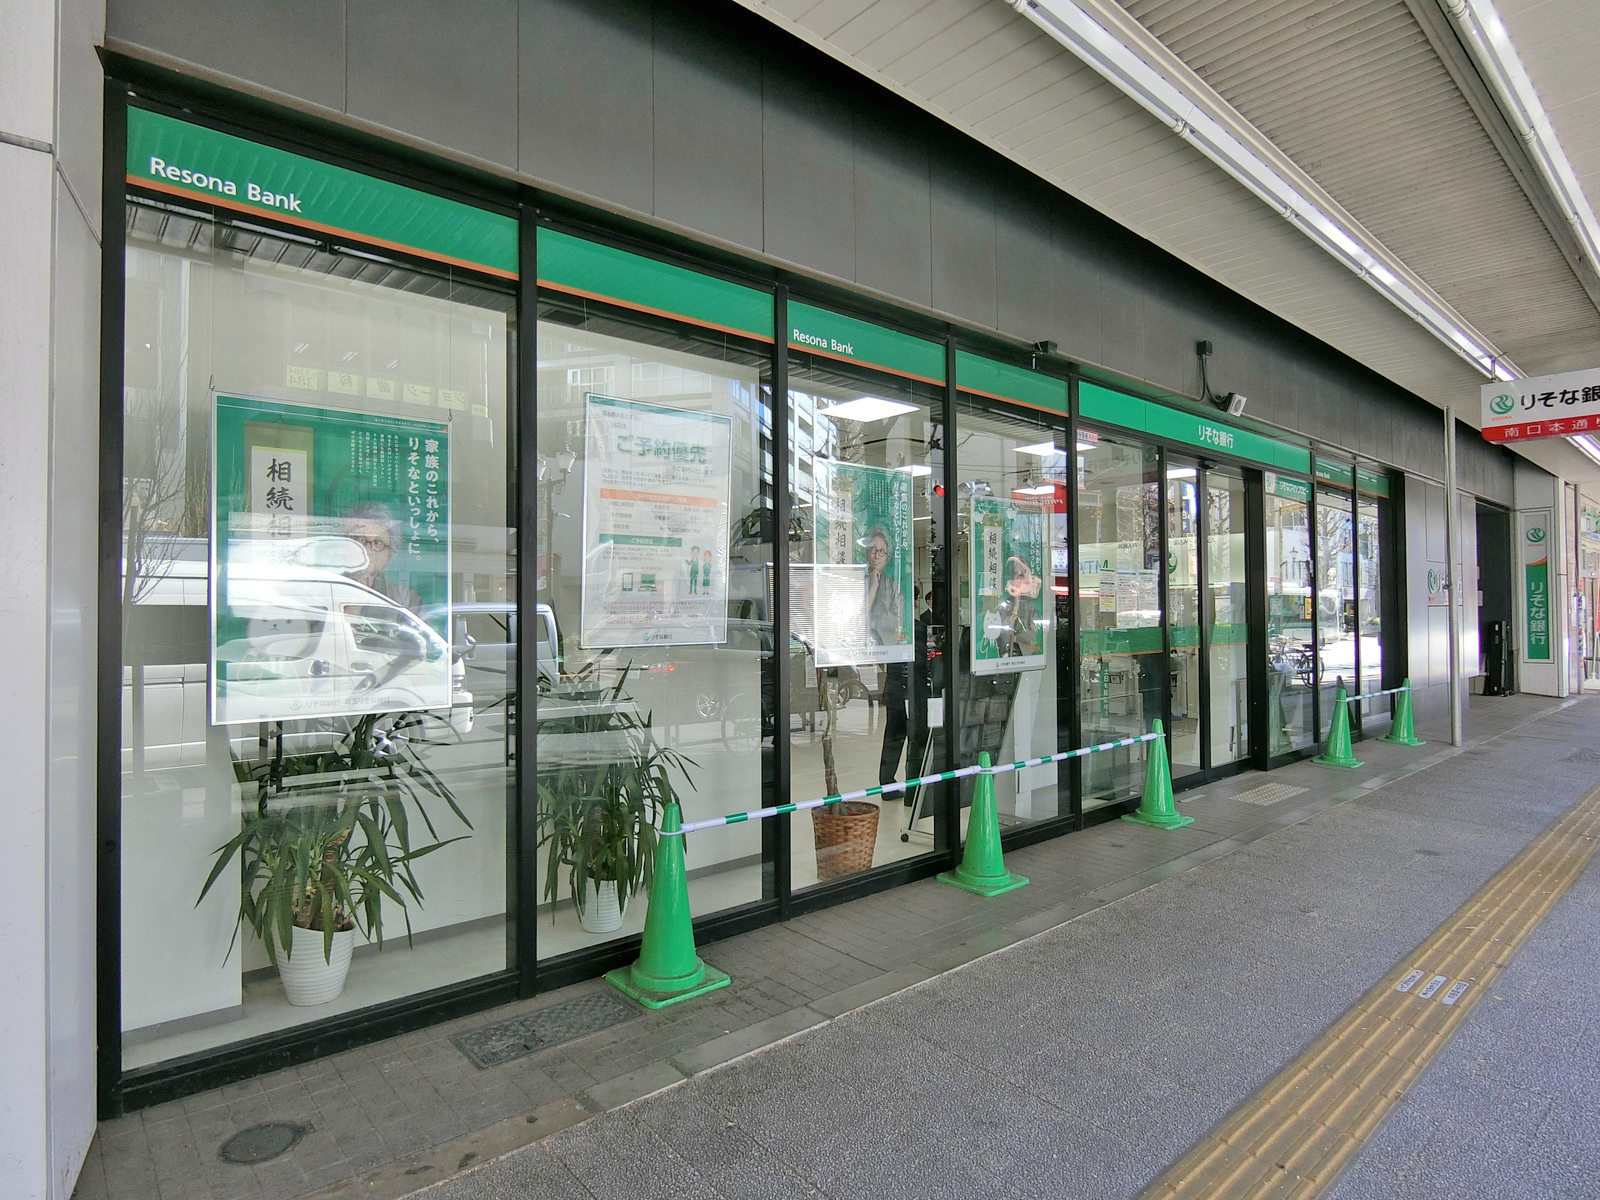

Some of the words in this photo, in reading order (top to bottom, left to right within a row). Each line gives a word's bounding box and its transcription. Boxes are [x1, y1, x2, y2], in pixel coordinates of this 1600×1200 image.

[149, 156, 237, 196] Resona
[246, 182, 303, 214] Bank
[793, 328, 828, 350] Resona
[831, 338, 855, 356] Bank
[617, 434, 707, 465] ご予約優先
[1198, 424, 1234, 449] りそな銀行
[406, 436, 421, 562] りそなといっしょに。
[424, 438, 440, 545] 家族のこれから、
[1530, 580, 1546, 645] りそな銀行
